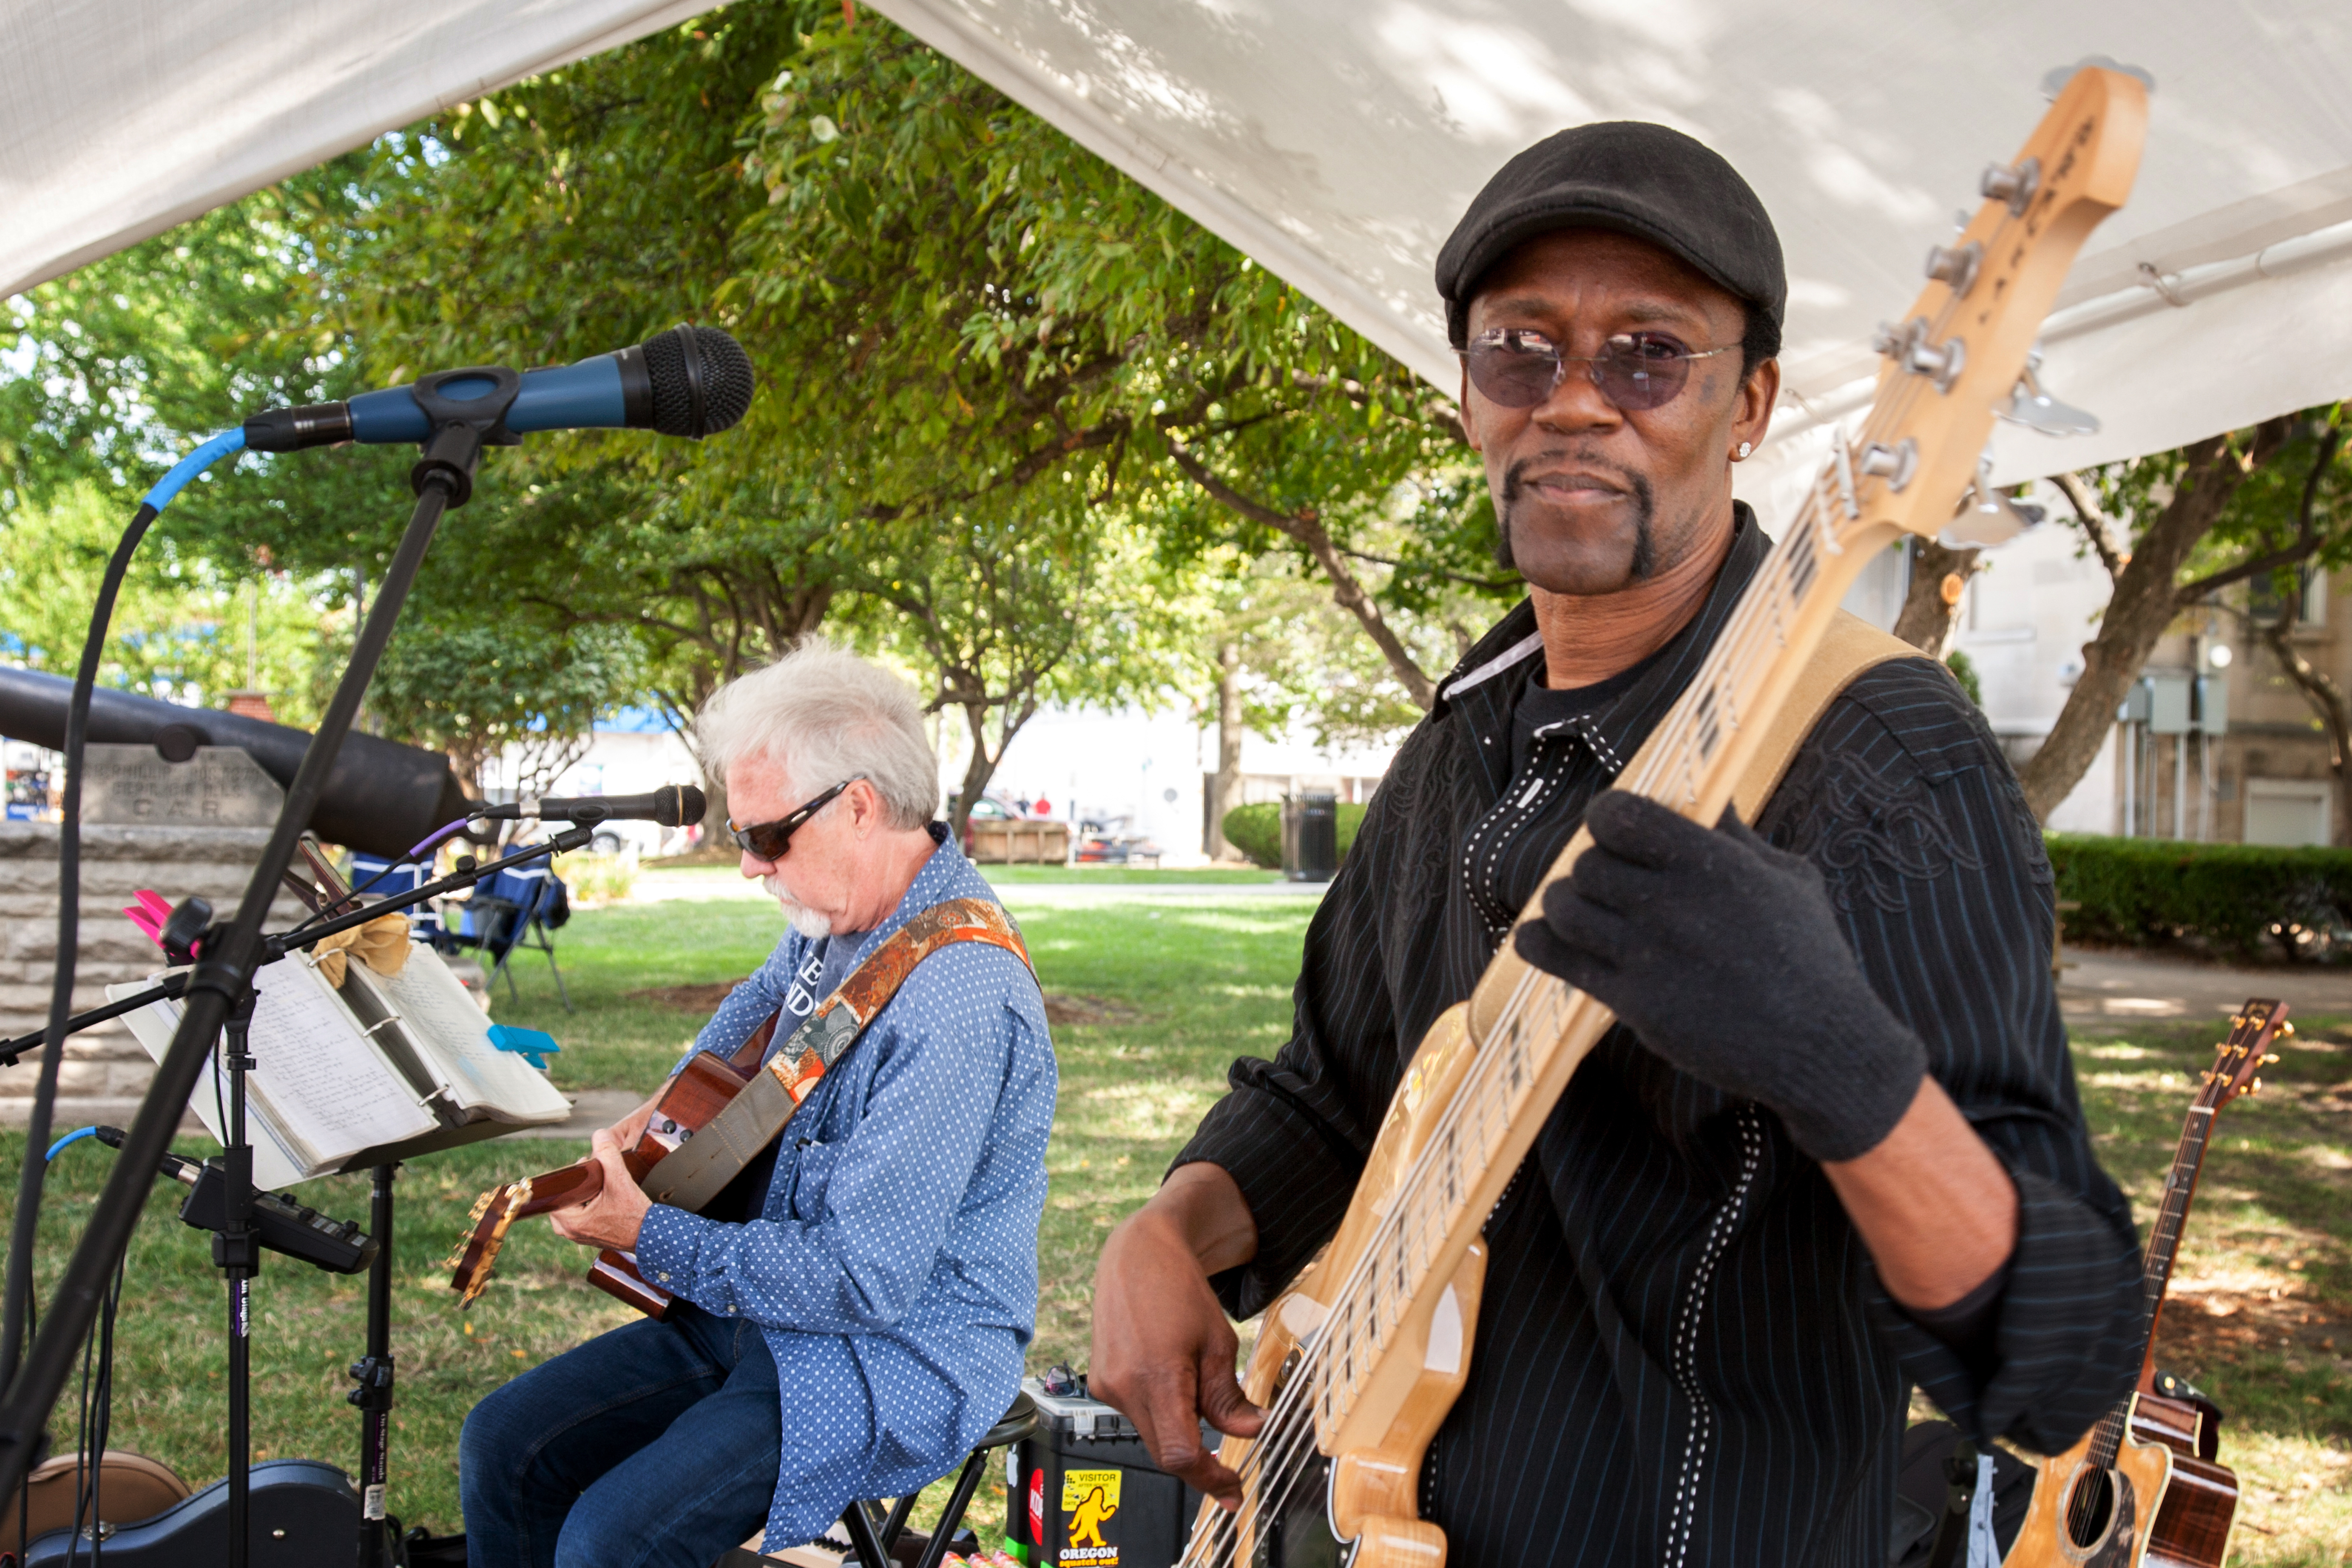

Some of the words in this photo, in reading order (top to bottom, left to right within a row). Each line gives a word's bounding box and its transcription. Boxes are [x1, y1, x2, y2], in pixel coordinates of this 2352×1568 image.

[1059, 1547, 1118, 1560] OREGON
[1059, 1558, 1097, 1568] squatch
[1098, 1557, 1119, 1565] out!
